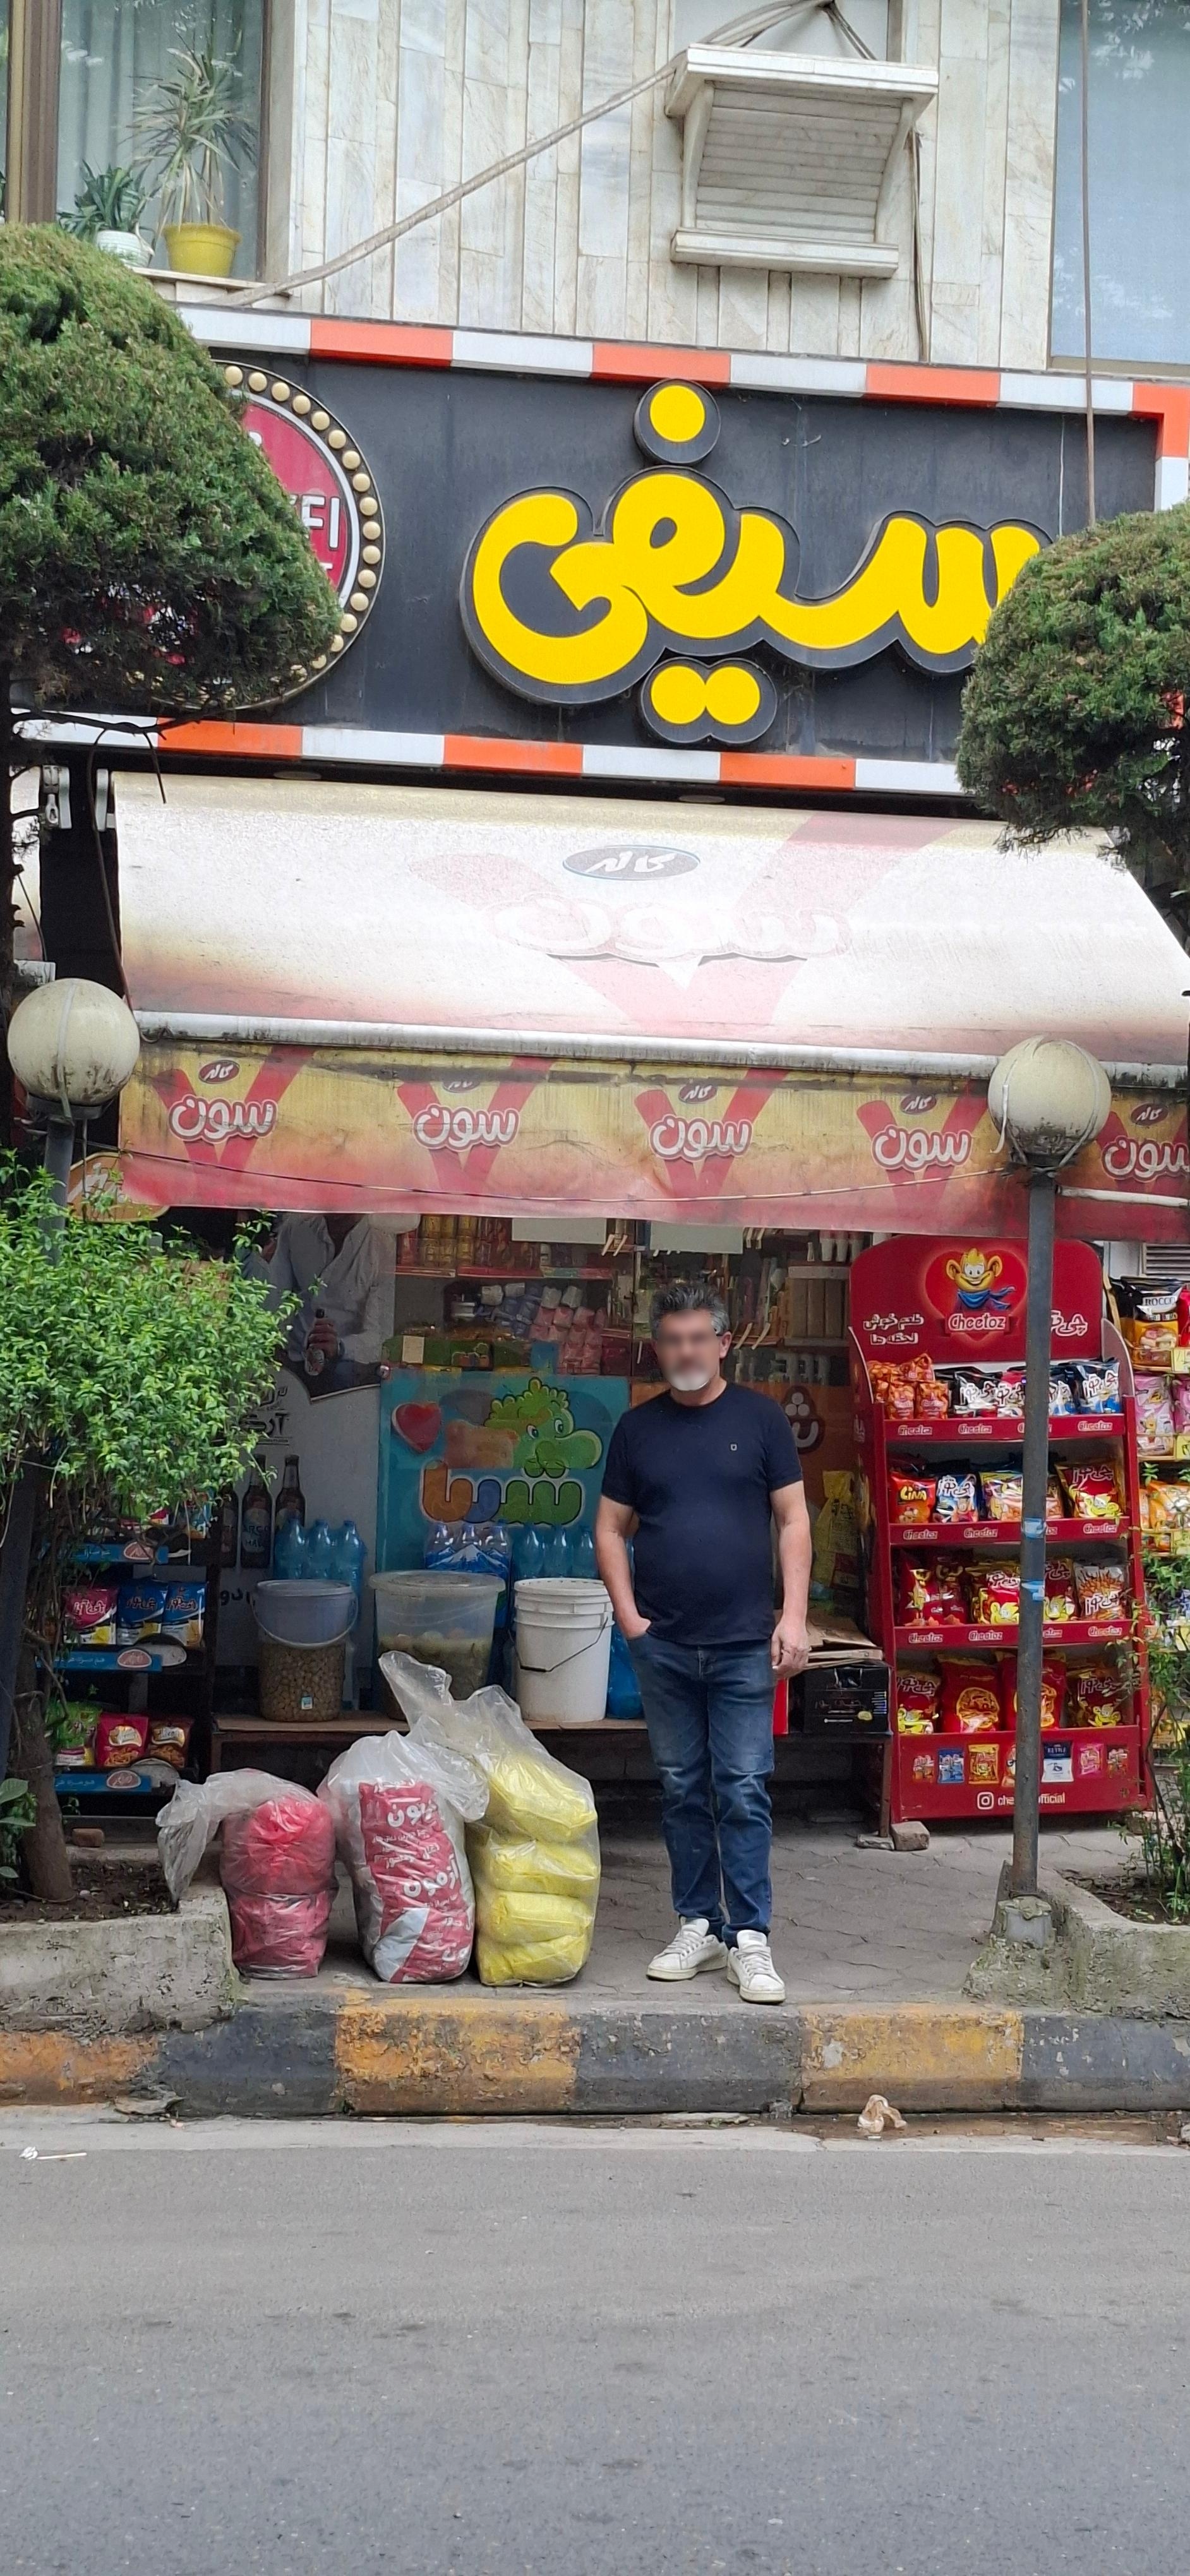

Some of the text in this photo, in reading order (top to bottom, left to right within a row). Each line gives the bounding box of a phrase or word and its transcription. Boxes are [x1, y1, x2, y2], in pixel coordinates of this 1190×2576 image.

[469, 380, 1043, 729] سیفی
[169, 1096, 277, 1142] سون
[414, 1105, 519, 1150] سون
[651, 1116, 752, 1160] سون
[873, 1126, 971, 1171] سون
[948, 1312, 1006, 1332] Cheetoz
